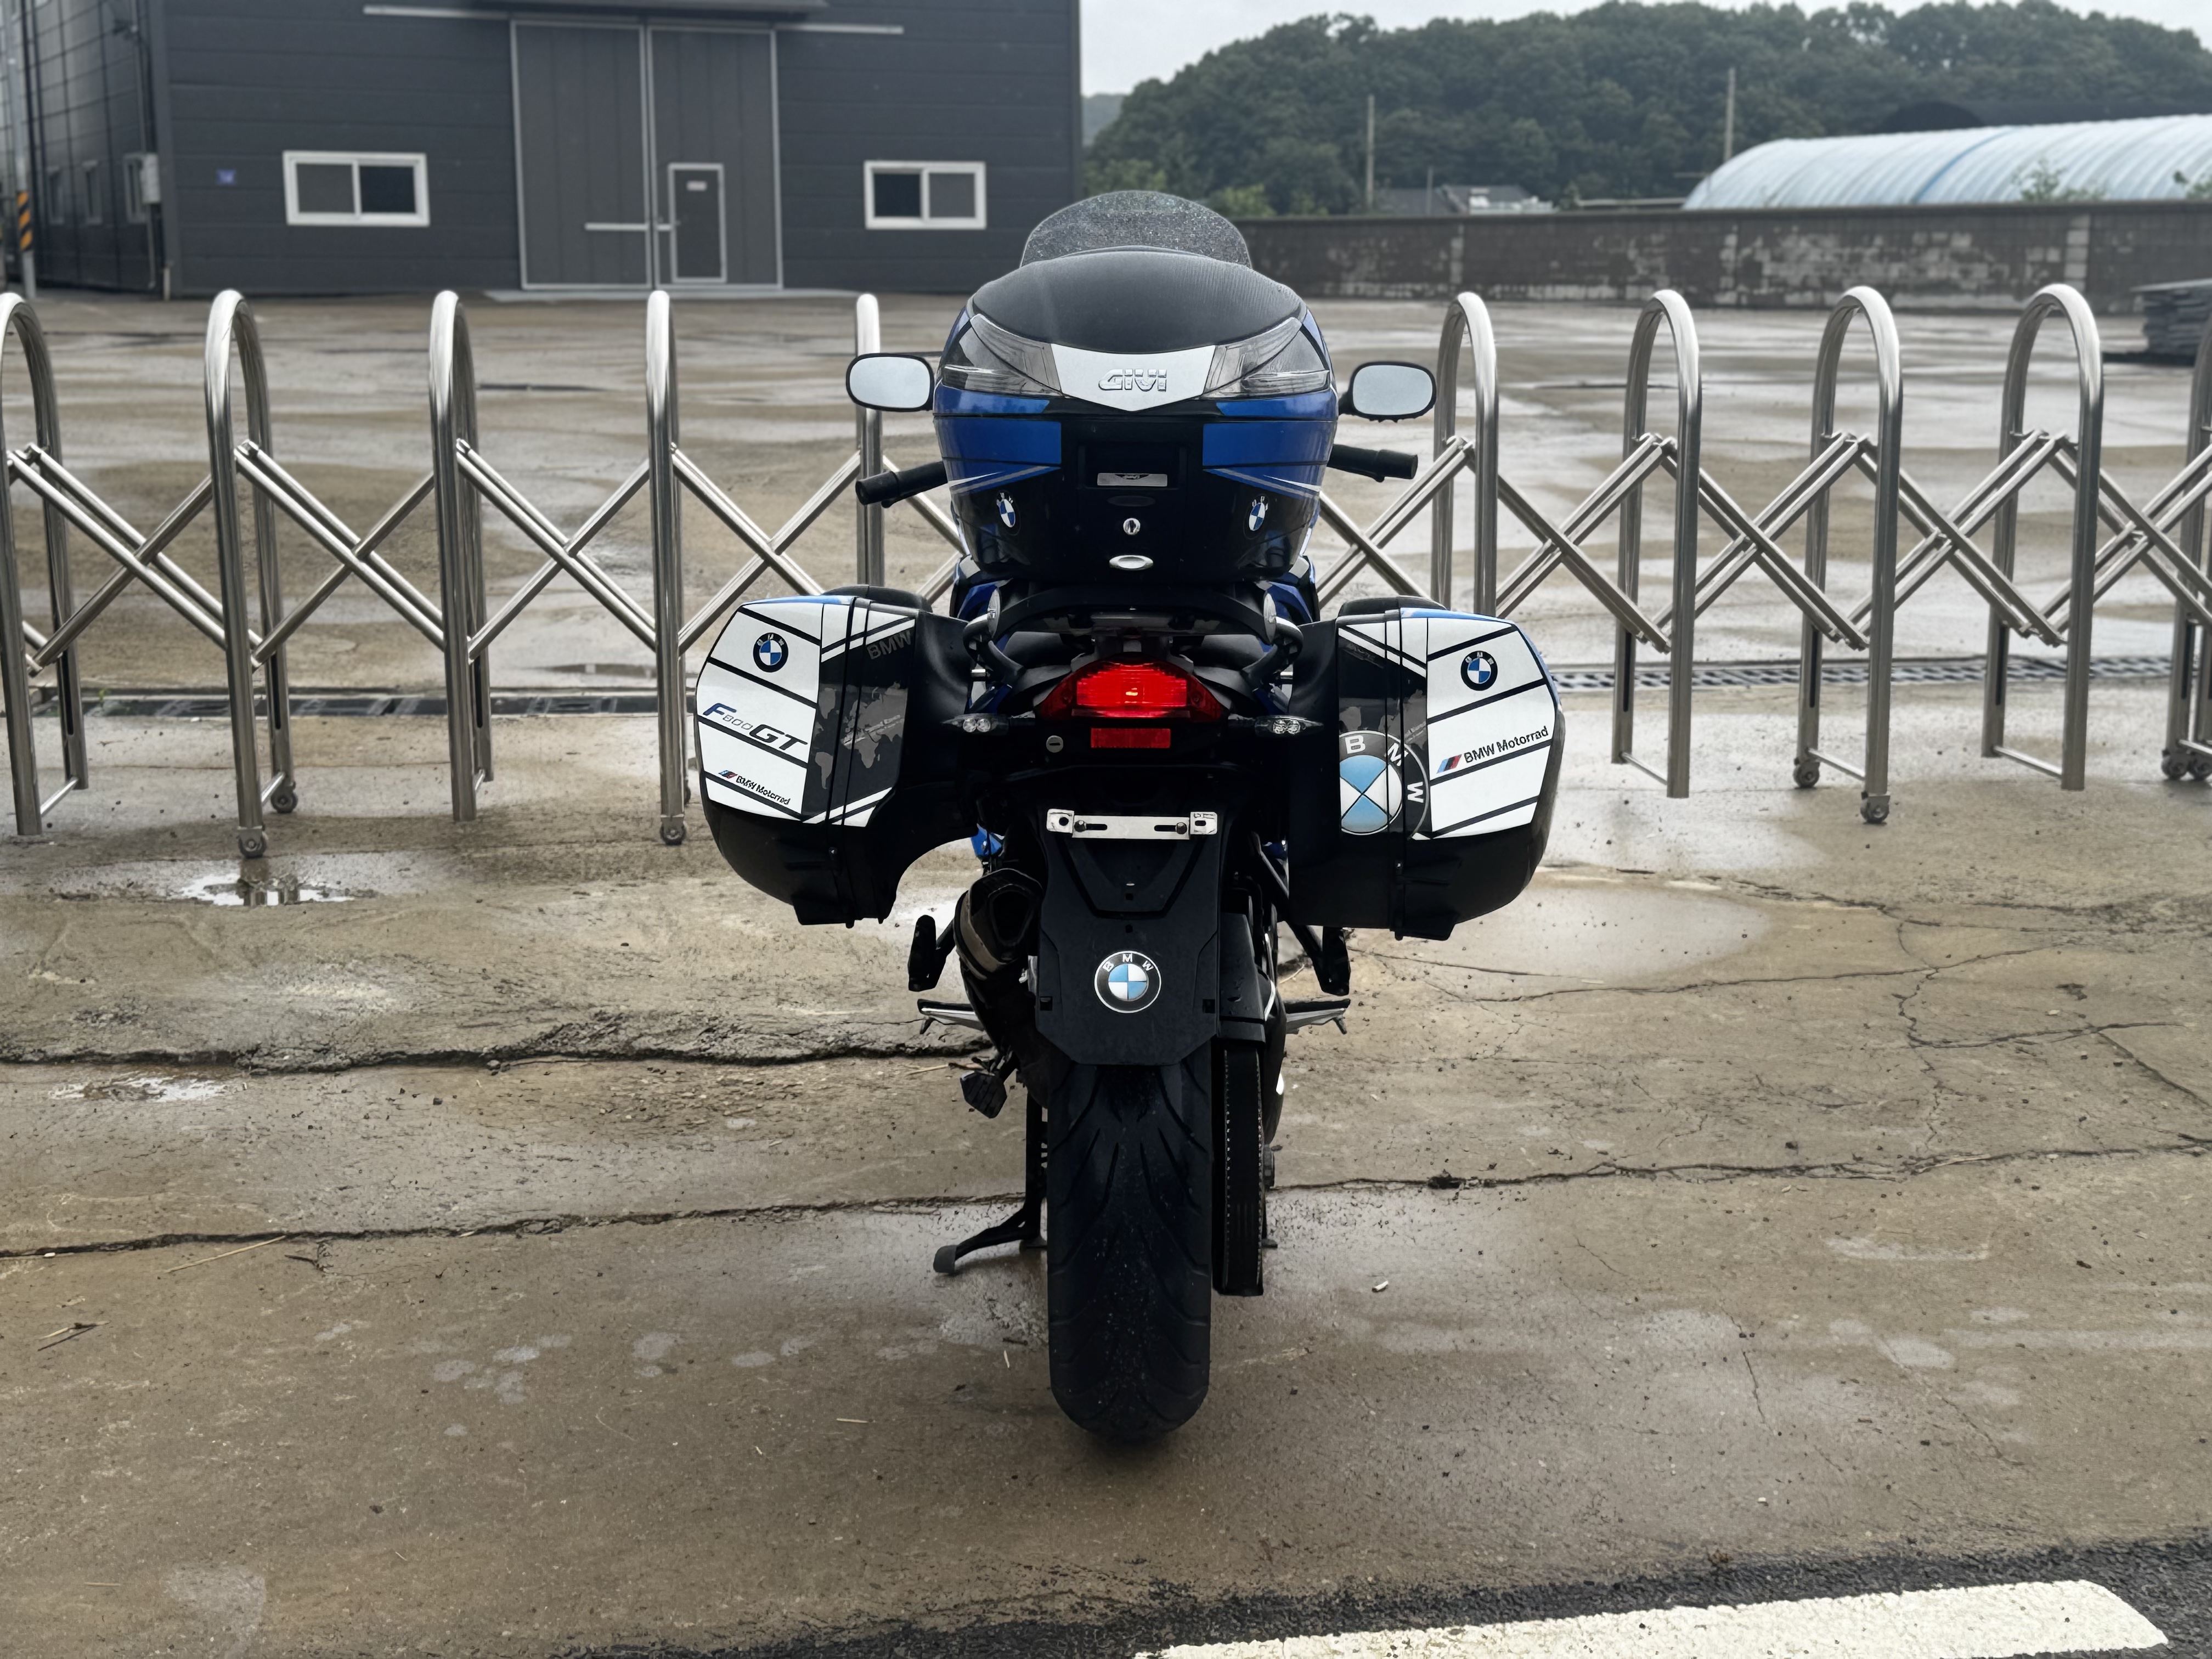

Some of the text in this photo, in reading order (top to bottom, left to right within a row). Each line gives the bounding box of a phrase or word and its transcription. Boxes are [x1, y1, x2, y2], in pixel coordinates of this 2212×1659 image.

[1098, 369, 1167, 392] GIVI
[867, 630, 911, 659] BMW
[1464, 725, 1549, 763] BMW Motorrad
[1102, 953, 1154, 972] BMW
